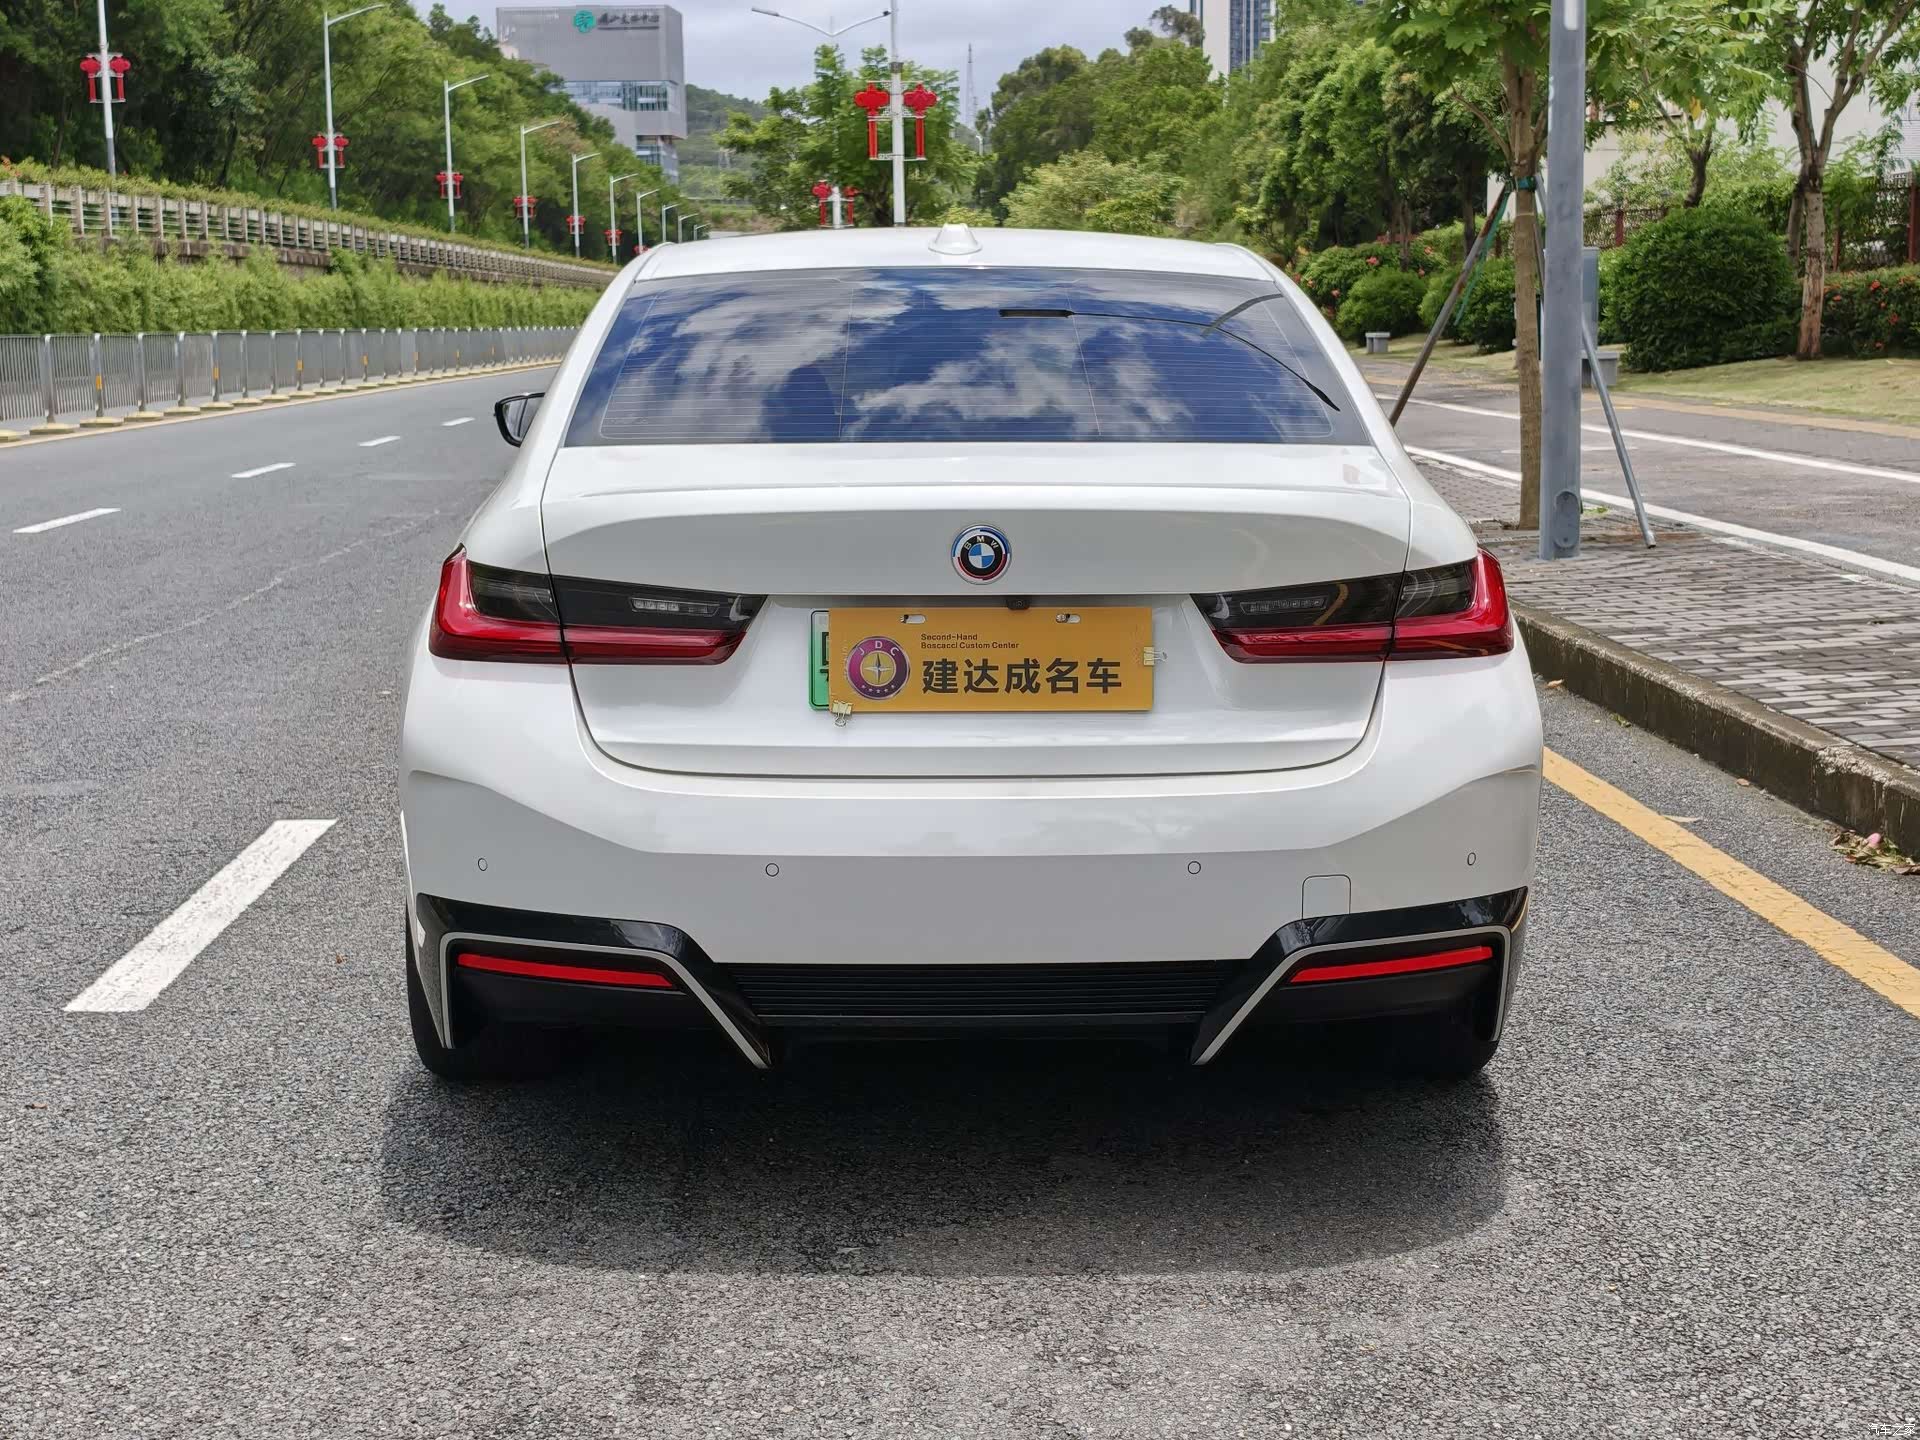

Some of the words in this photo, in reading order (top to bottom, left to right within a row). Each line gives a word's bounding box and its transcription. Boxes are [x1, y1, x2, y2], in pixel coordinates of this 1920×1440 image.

[963, 535, 999, 551] BMW
[920, 633, 978, 641] Second-Hand
[959, 641, 991, 649] Custom
[991, 641, 1020, 649] Center
[858, 640, 900, 656] JDC
[922, 657, 1122, 694] 建达成名车
